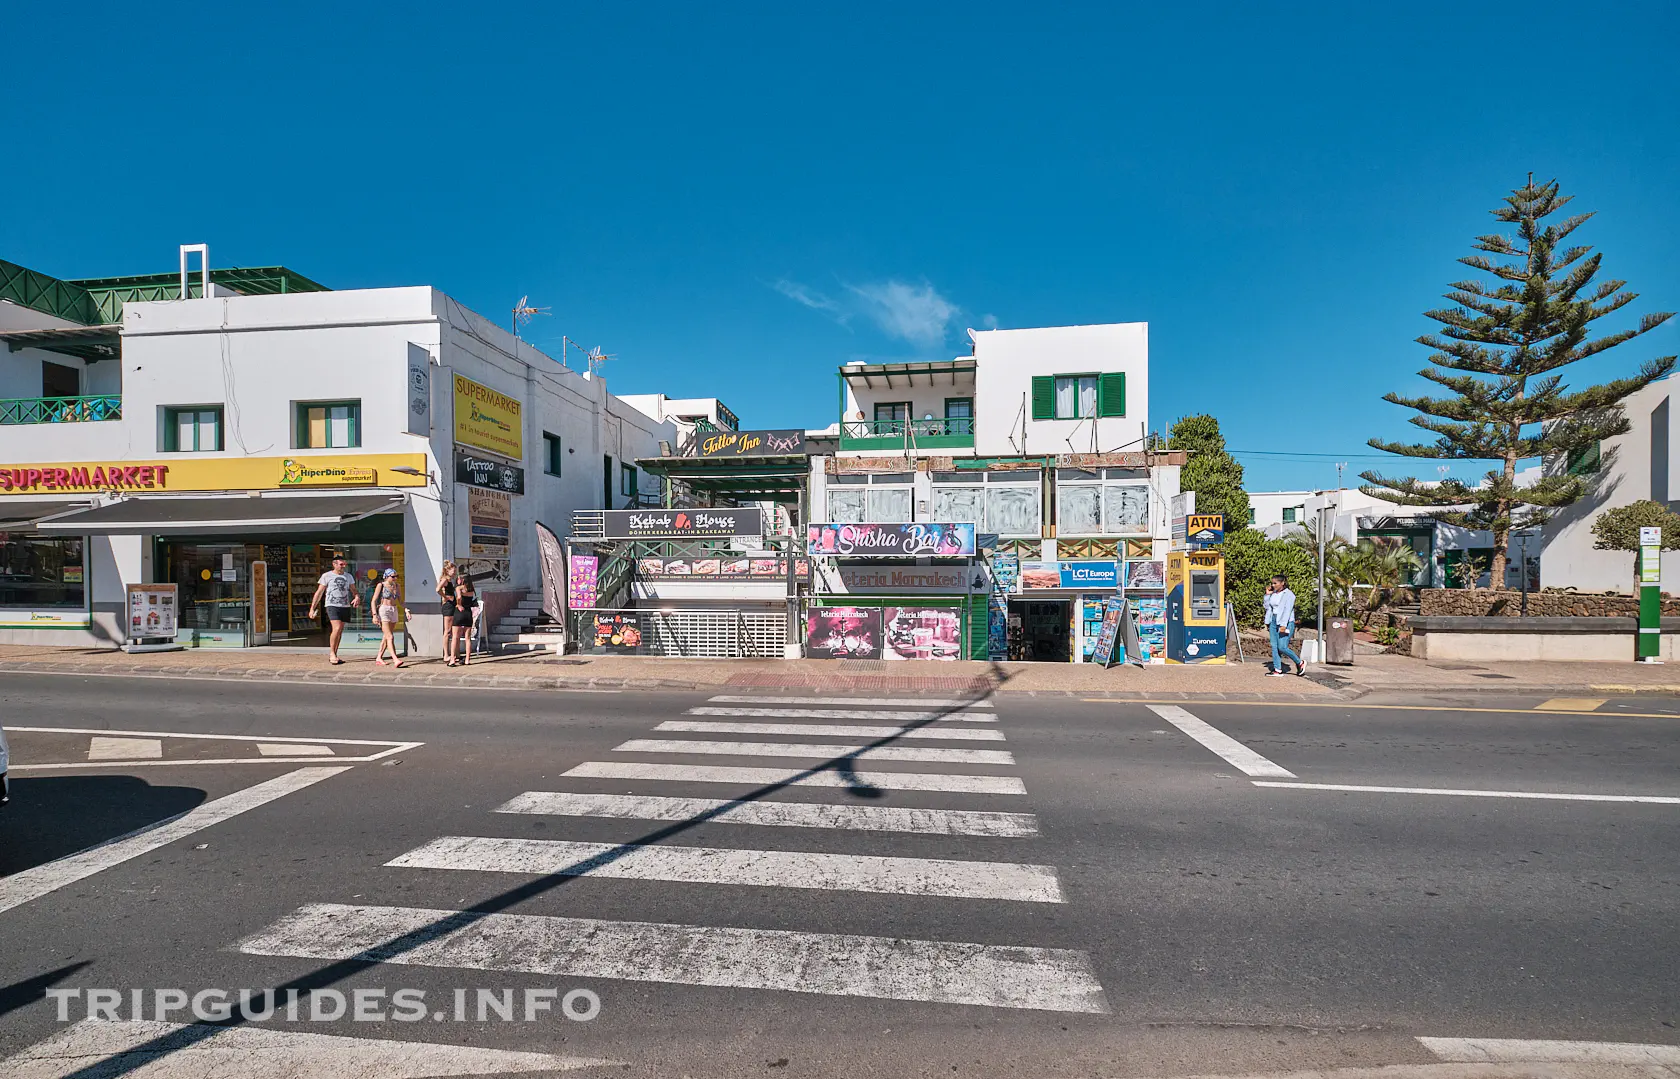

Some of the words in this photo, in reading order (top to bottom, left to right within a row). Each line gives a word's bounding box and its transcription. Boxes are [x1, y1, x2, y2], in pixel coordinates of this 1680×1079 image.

[456, 378, 520, 416] SUPERMARKET
[460, 422, 467, 431] #1
[468, 425, 474, 433] in
[474, 428, 490, 438] tourist
[490, 434, 519, 448] supermarkets
[737, 434, 760, 454] Inn
[0, 465, 168, 490] SUPERMARKET
[300, 469, 346, 477] HiperDino
[629, 513, 672, 529] Kebab
[695, 513, 736, 529] House
[1190, 517, 1221, 527] ATM
[731, 536, 762, 544] ENTRANCE
[838, 525, 899, 554] Shisha
[903, 525, 943, 555] Bar
[1170, 558, 1181, 569] ATM
[1191, 557, 1216, 566] ATM
[892, 571, 966, 587] Marrakech
[1072, 569, 1090, 578] LCT
